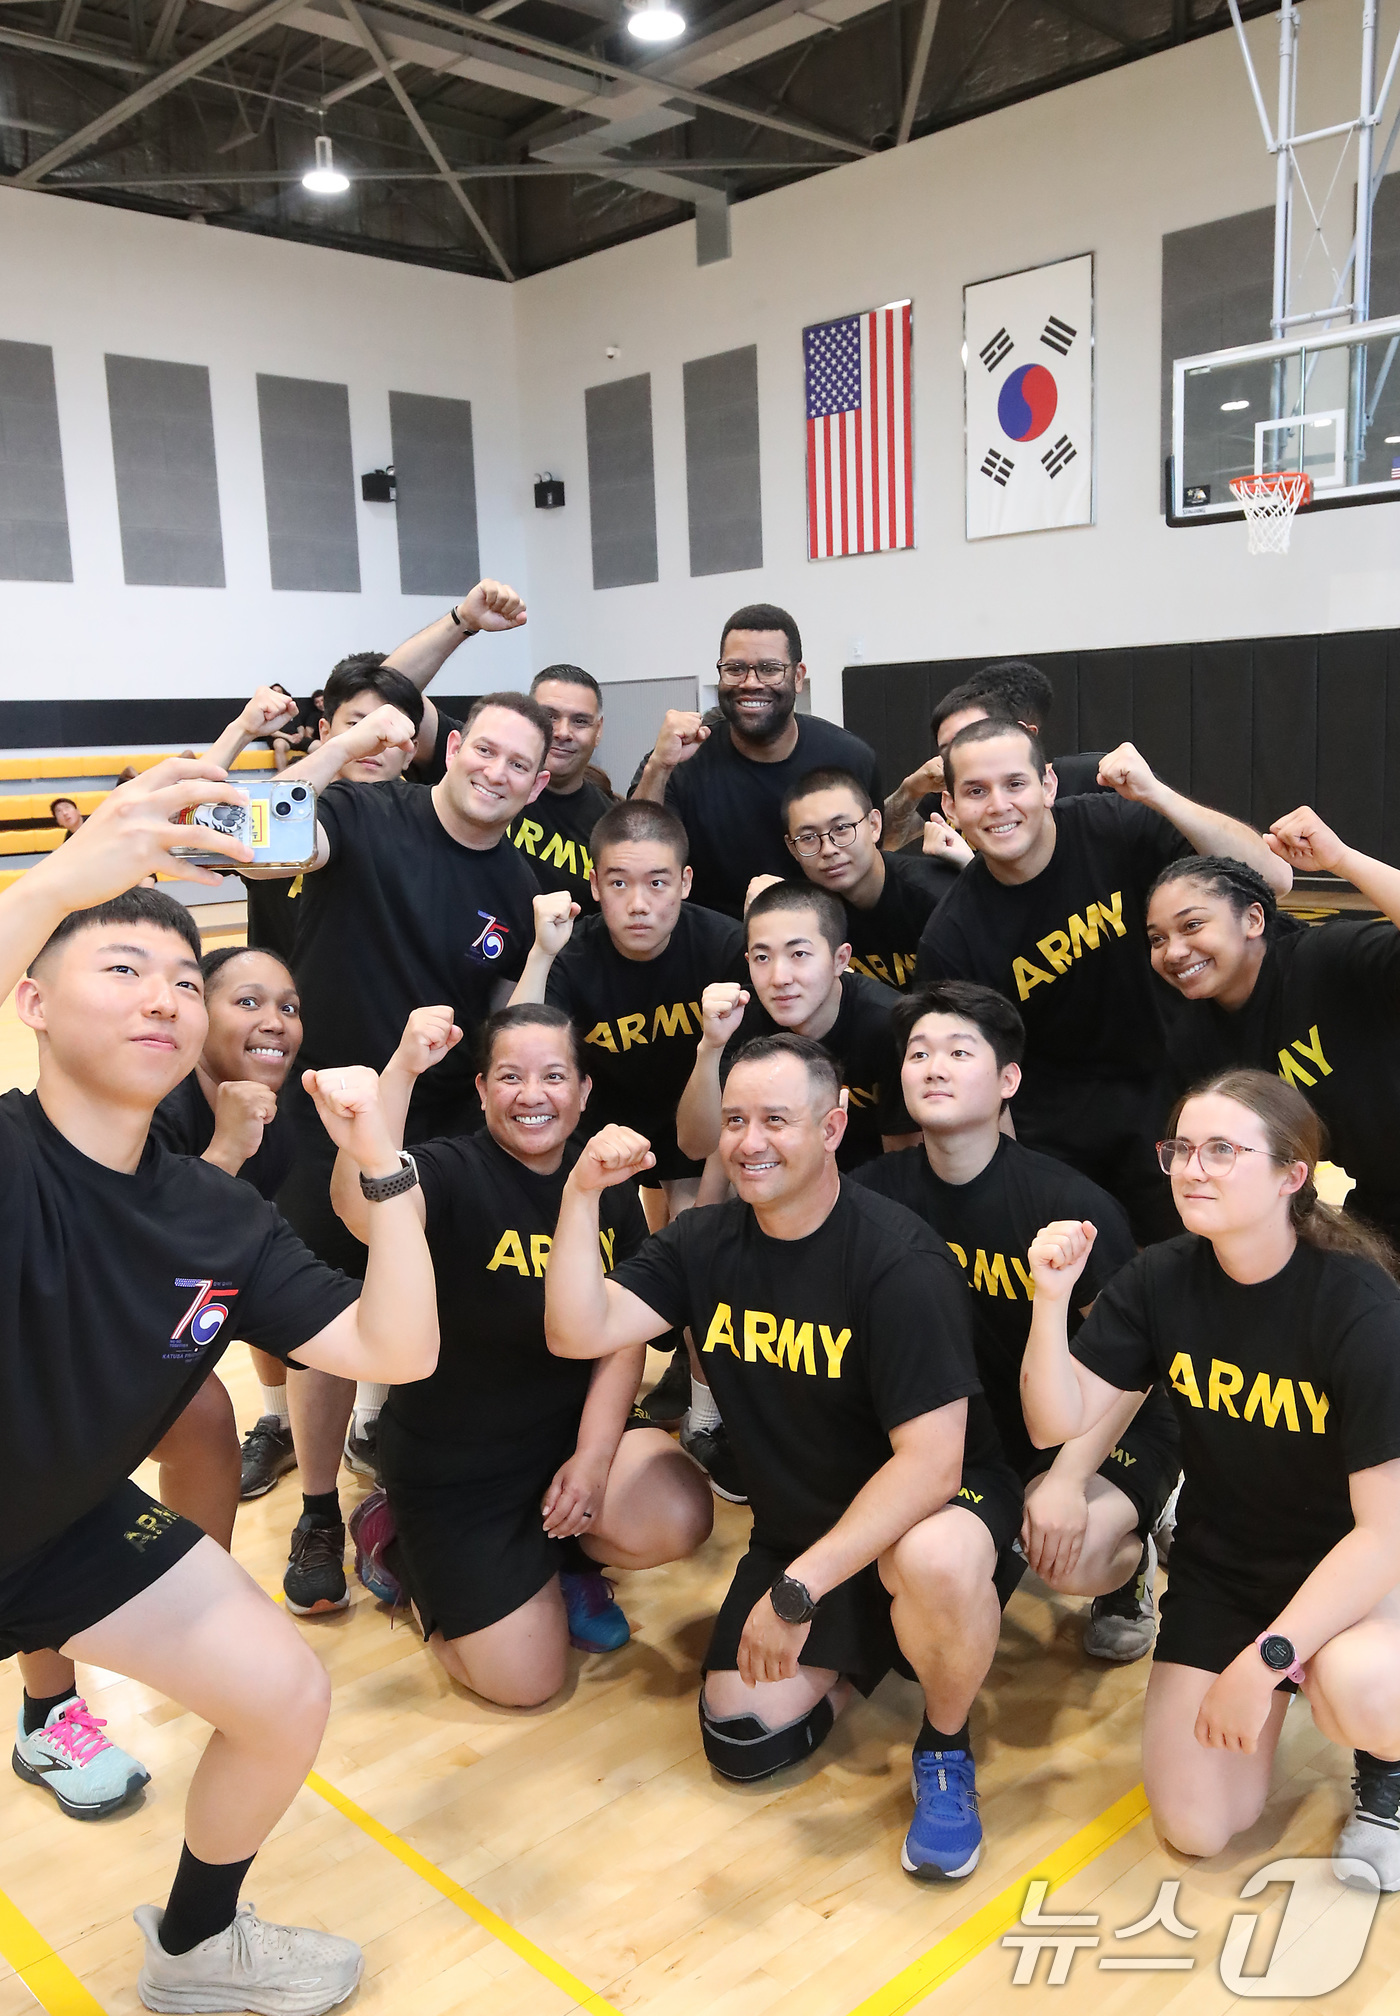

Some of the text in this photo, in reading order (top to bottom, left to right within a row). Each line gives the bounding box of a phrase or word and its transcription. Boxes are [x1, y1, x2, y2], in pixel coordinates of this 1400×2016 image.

[506, 817, 594, 881] RMY
[1012, 891, 1127, 1001] ARMY
[1278, 1024, 1333, 1092] MY
[486, 1227, 615, 1278] ARY
[946, 1242, 1035, 1301] MY
[702, 1302, 853, 1379] ARMY
[1168, 1351, 1330, 1434] ARMY
[1109, 1446, 1137, 1468] MY
[957, 1487, 984, 1504] MY
